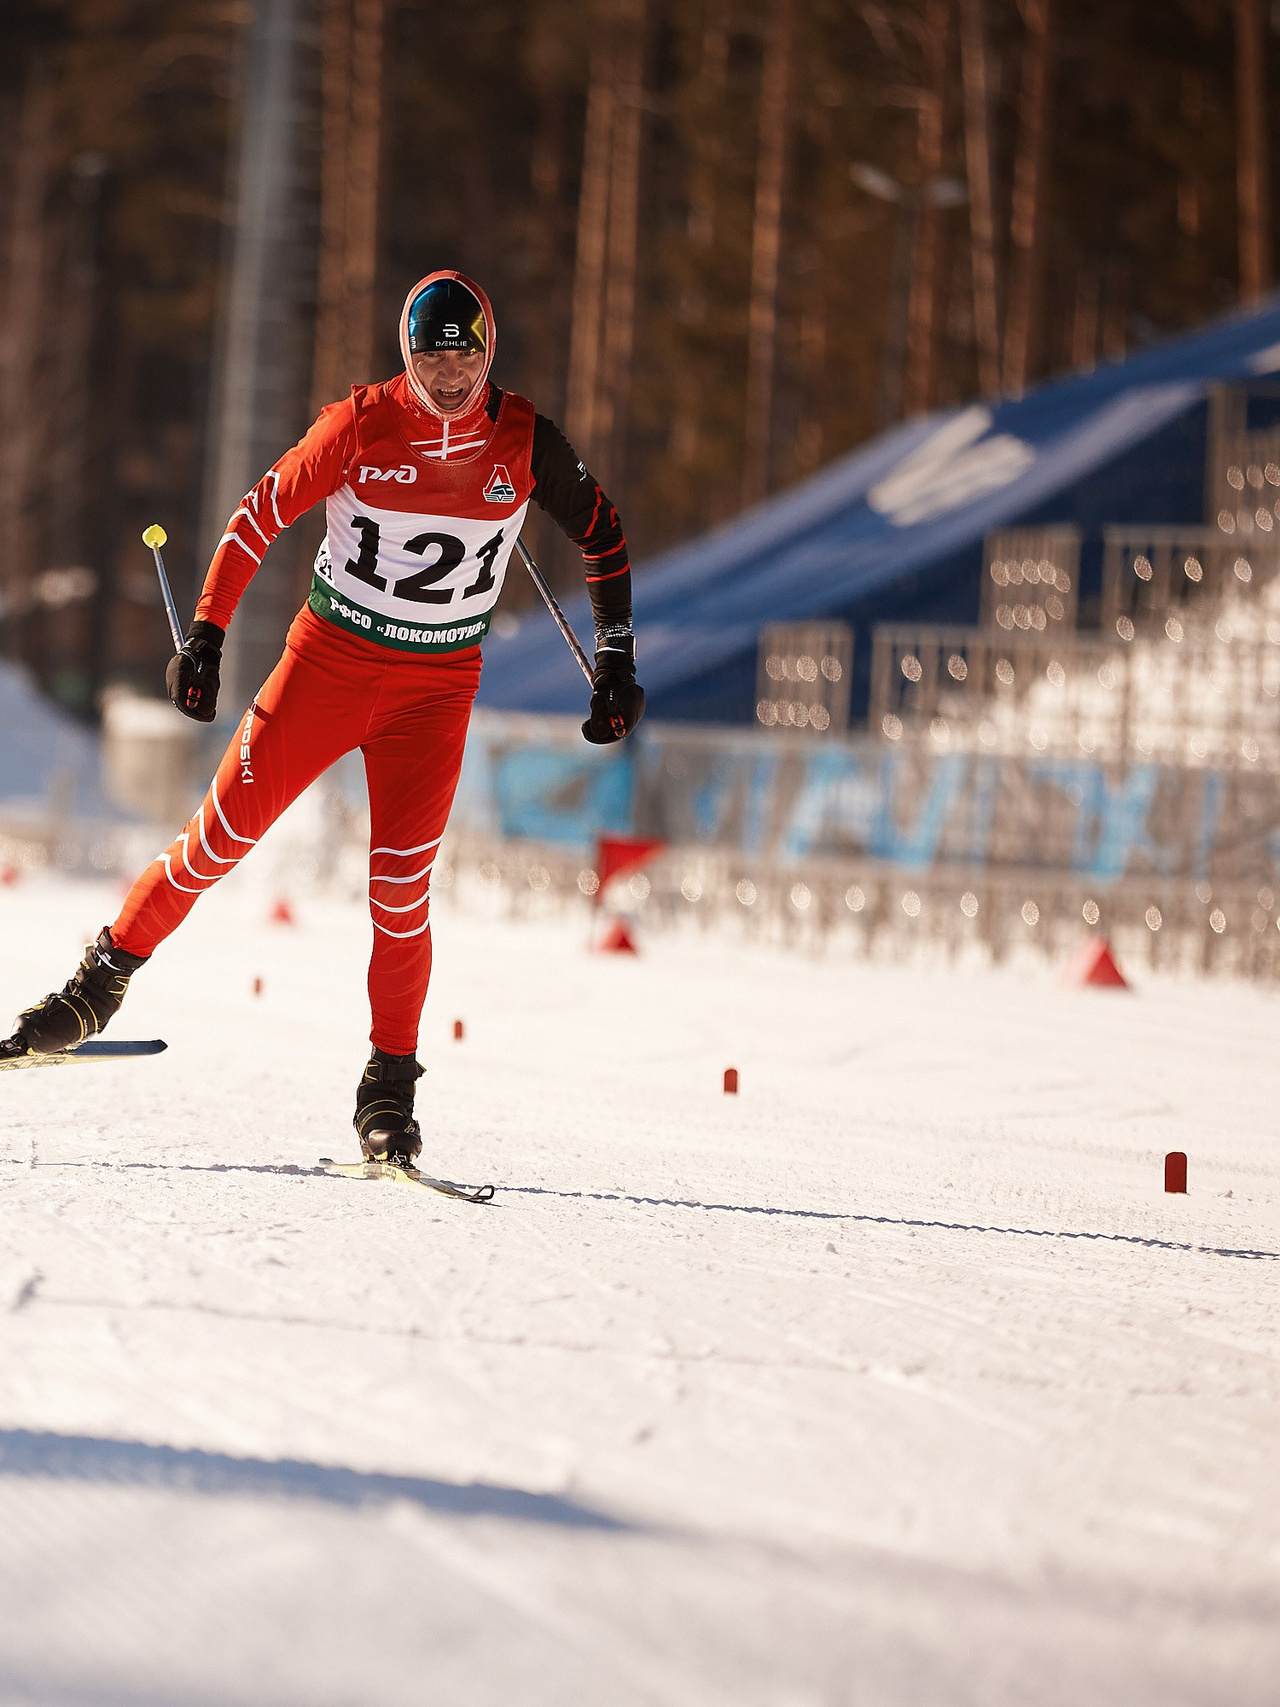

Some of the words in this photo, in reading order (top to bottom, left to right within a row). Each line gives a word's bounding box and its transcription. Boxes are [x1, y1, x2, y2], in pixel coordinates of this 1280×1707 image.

[358, 464, 418, 484] РЖД
[344, 514, 505, 605] 121
[329, 596, 373, 630] РФСО
